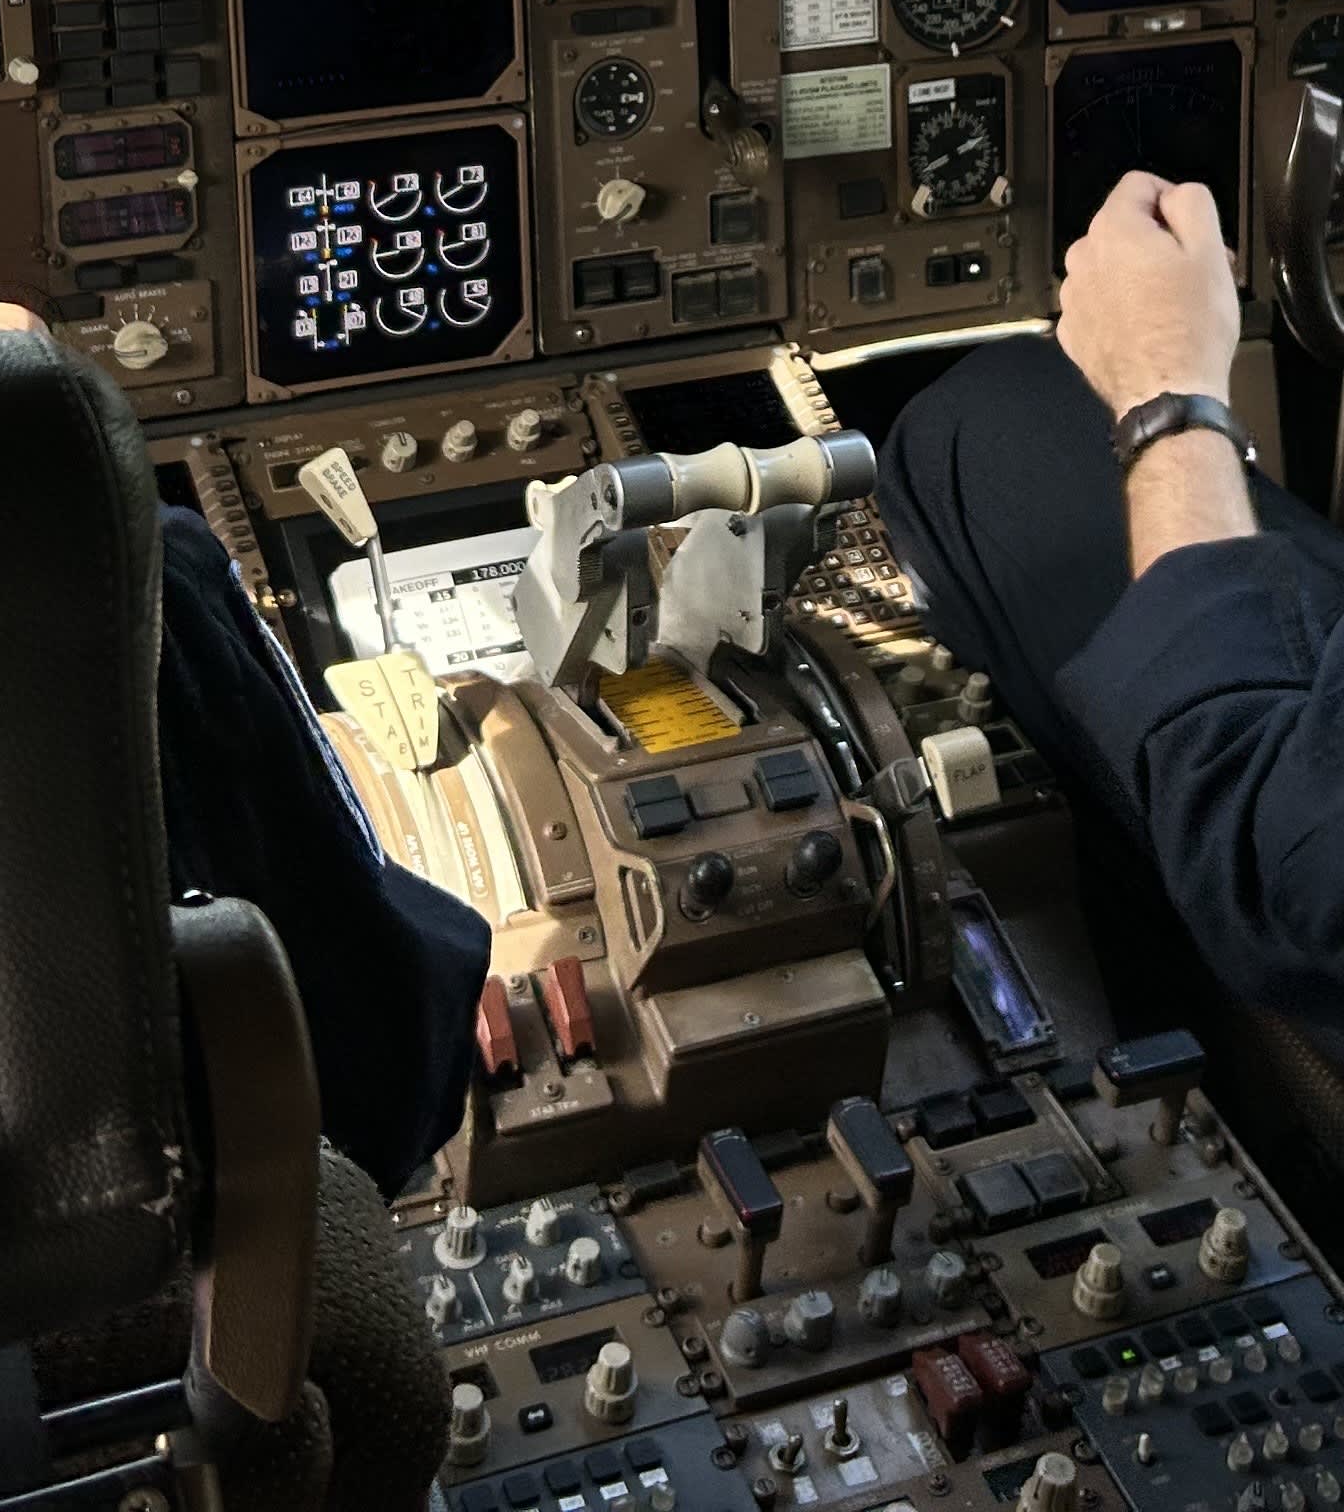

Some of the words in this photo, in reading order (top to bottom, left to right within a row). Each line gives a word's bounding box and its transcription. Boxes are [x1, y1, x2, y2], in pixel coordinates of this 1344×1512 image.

[322, 469, 348, 500] BRAKE
[330, 460, 357, 492] SPEED
[391, 578, 438, 595] AKEOFF
[359, 679, 407, 754] STAB
[403, 667, 429, 748] TRIM
[954, 763, 986, 782] FLAP
[494, 1332, 542, 1351] COMM
